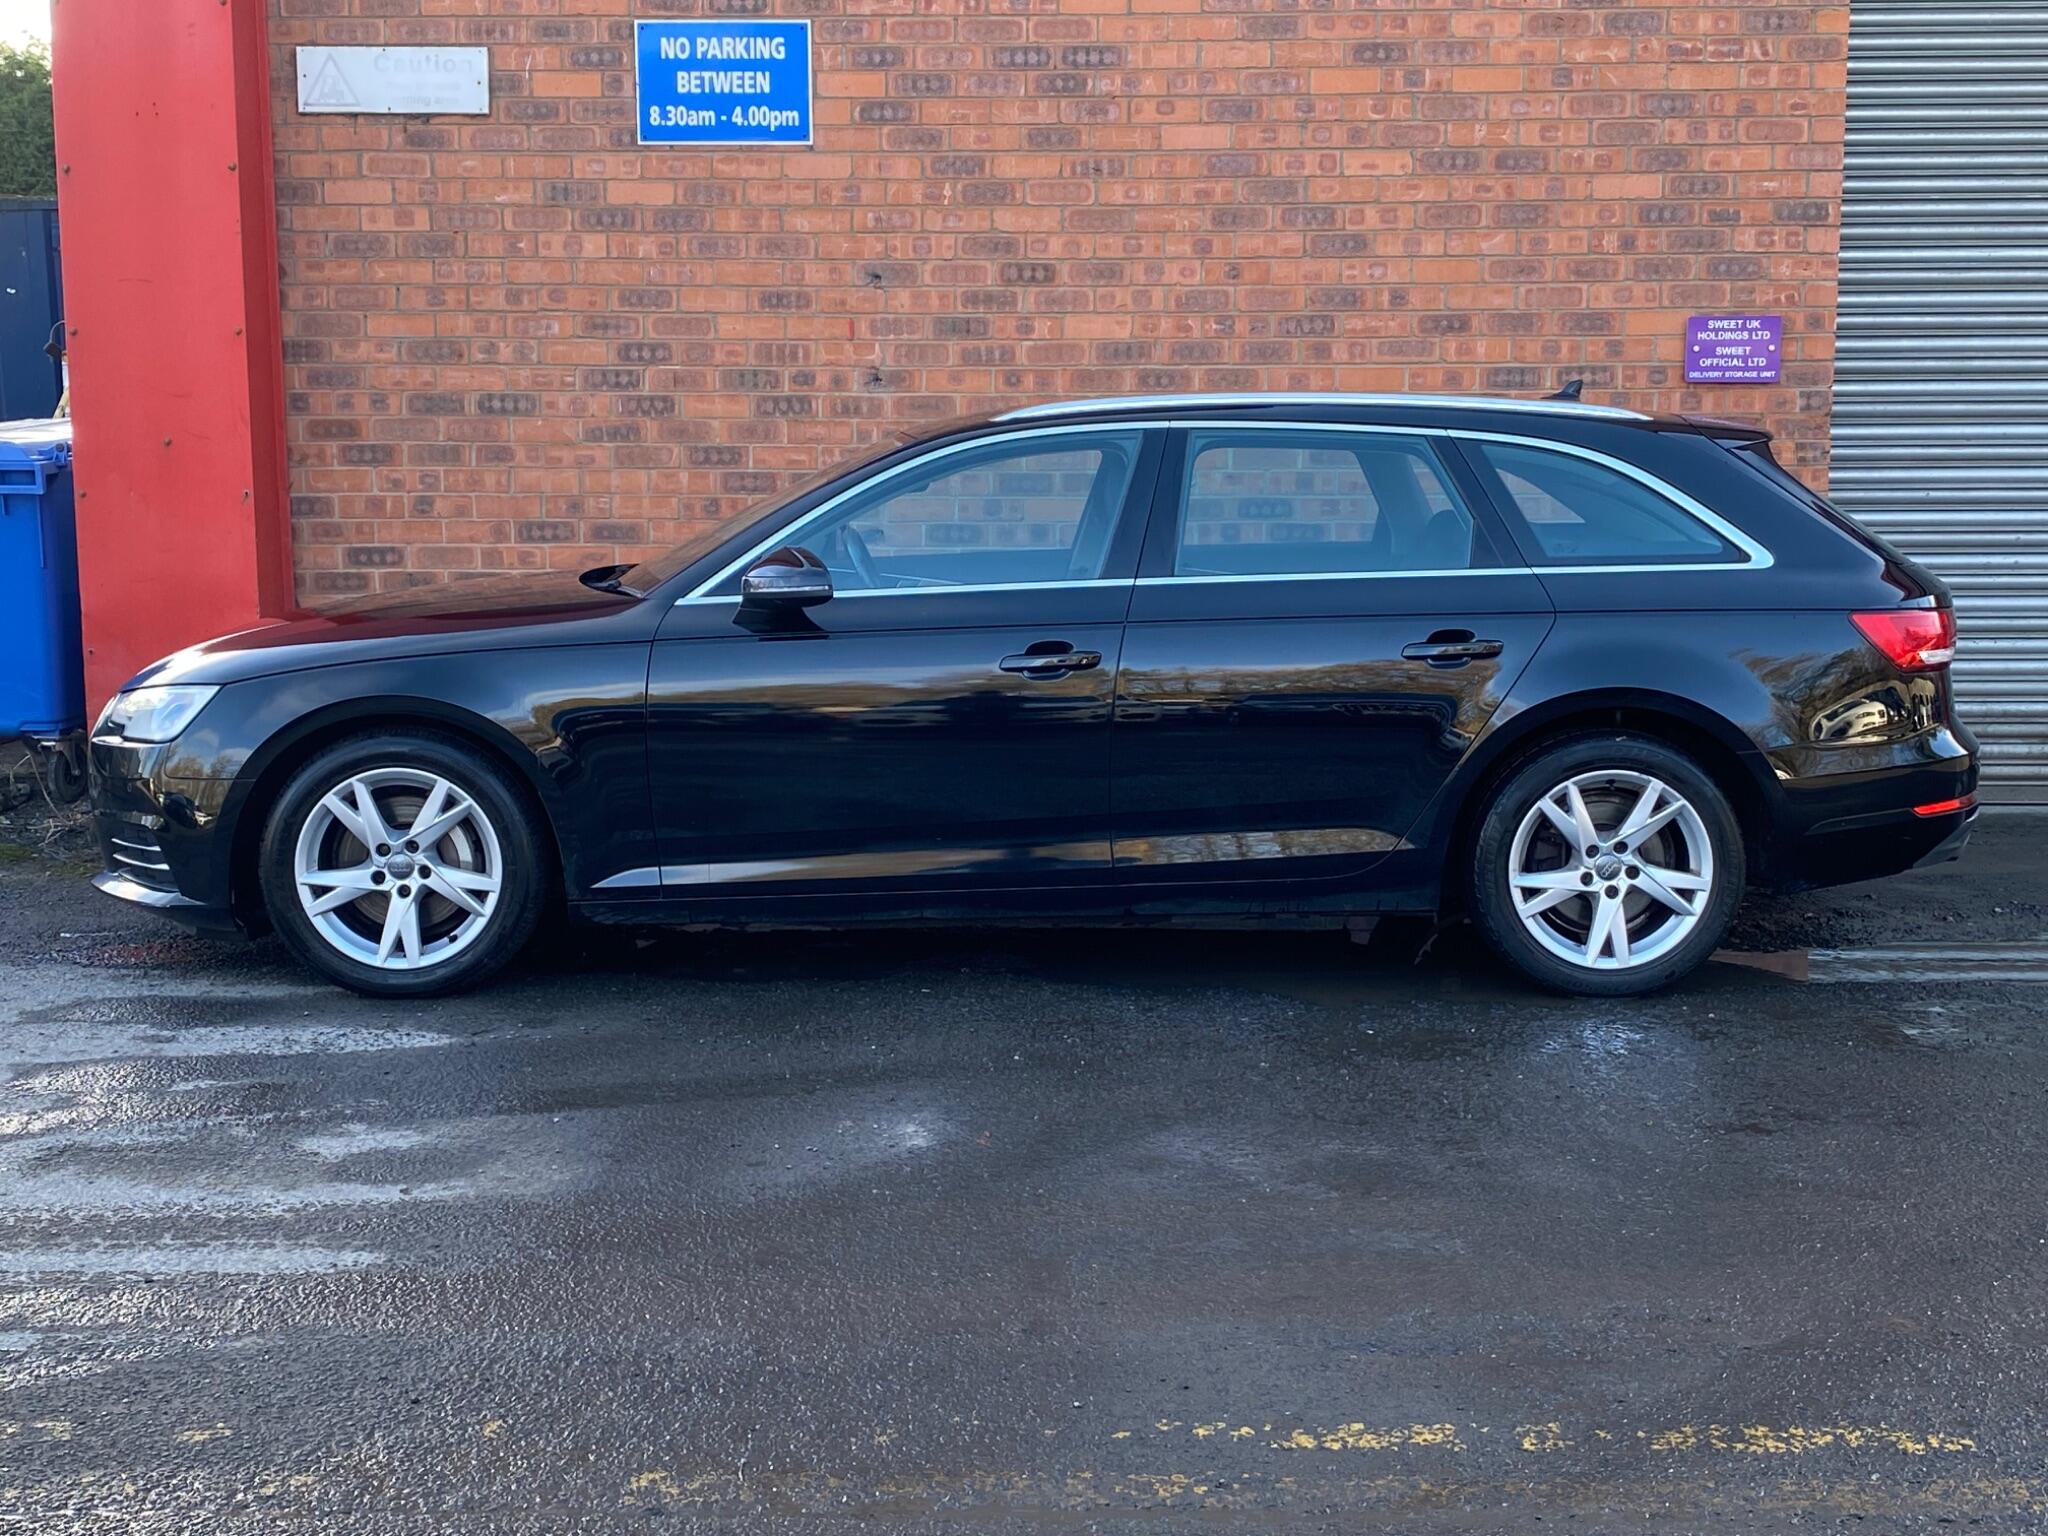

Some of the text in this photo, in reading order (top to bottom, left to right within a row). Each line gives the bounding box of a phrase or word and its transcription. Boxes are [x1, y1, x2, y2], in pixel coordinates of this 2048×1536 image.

[660, 36, 786, 60] NO PARKING
[373, 53, 473, 73] Caution
[676, 71, 771, 94] BETWEEN
[649, 105, 716, 127] 8.30am
[731, 105, 800, 132] 4.00pm
[1707, 319, 1761, 329] SWEET UK
[1697, 330, 1771, 340] HOLDINGS LTD
[1715, 346, 1752, 355] SWEET
[1699, 357, 1767, 367] OFFICIAL LTD
